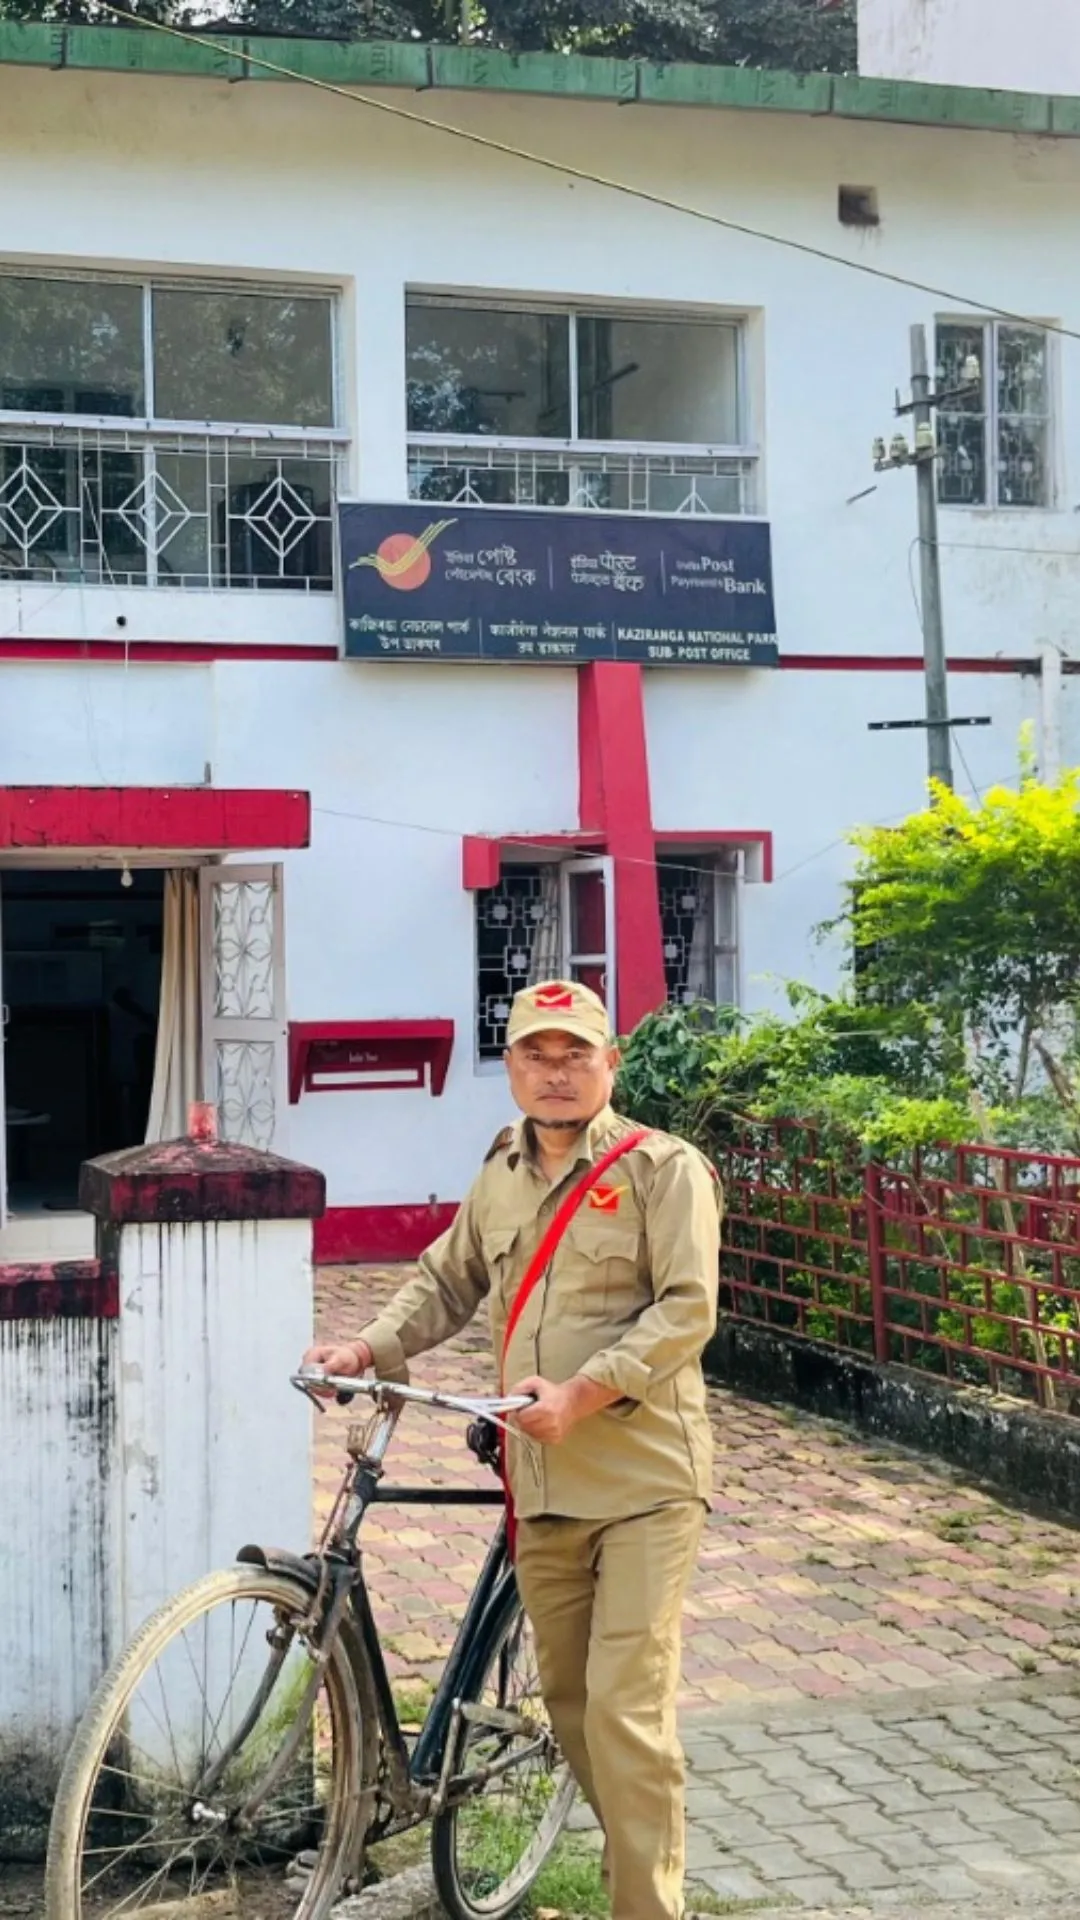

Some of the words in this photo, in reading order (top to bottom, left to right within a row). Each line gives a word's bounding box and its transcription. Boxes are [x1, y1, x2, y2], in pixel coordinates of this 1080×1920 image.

[600, 550, 637, 570] पोस्ट
[702, 557, 735, 573] Post
[497, 569, 537, 587] বেংক
[613, 571, 645, 591] बैंक
[672, 576, 723, 590] Payments
[725, 578, 766, 595] Bank
[584, 622, 607, 639] पार्क
[618, 627, 685, 643] KAZIRANGA
[688, 631, 745, 645] NATIONAL
[748, 633, 779, 646] PARK
[678, 647, 707, 660] POST
[711, 649, 751, 661] OFFICE
